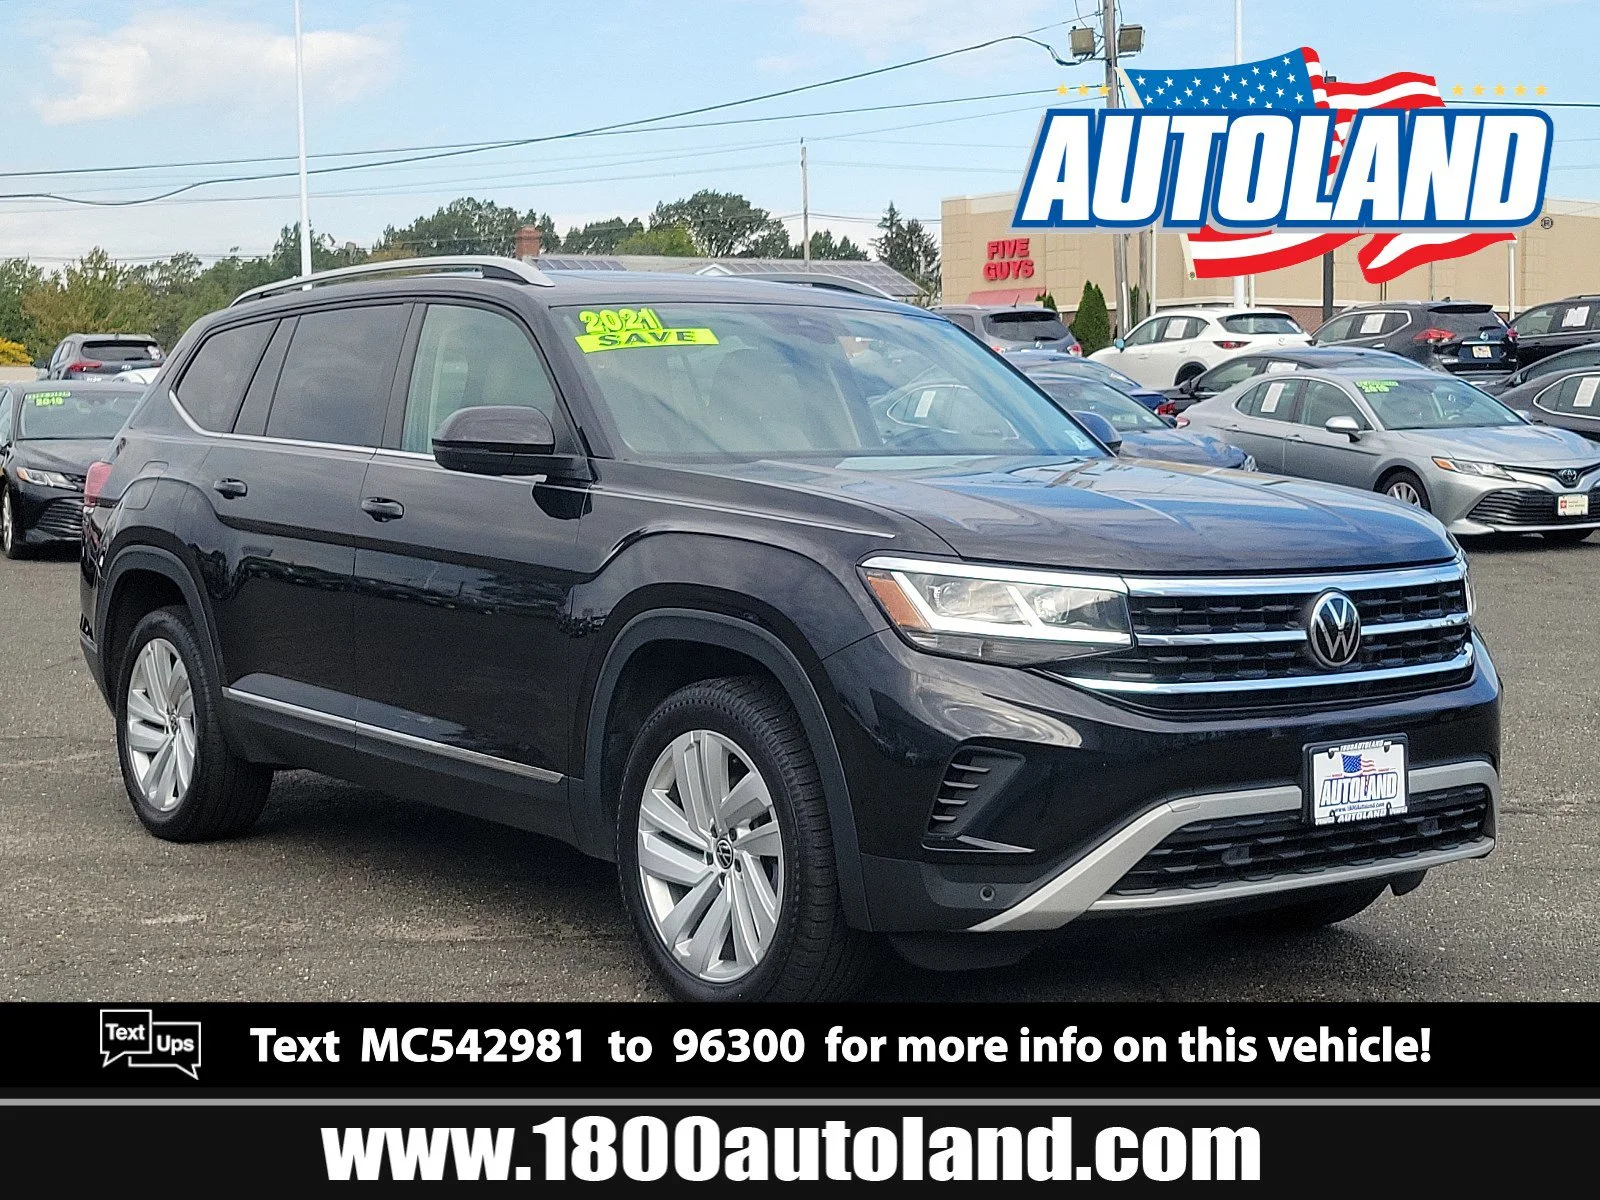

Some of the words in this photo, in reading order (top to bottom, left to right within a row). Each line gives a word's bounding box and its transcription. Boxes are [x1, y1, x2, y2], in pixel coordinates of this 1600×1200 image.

[987, 238, 1030, 260] FIVE
[983, 259, 1034, 281] GUYS
[578, 308, 663, 333] 2021
[598, 330, 697, 347] SAVE
[1320, 773, 1399, 807] AUTOLAND
[1337, 809, 1387, 823] AUTOLAND
